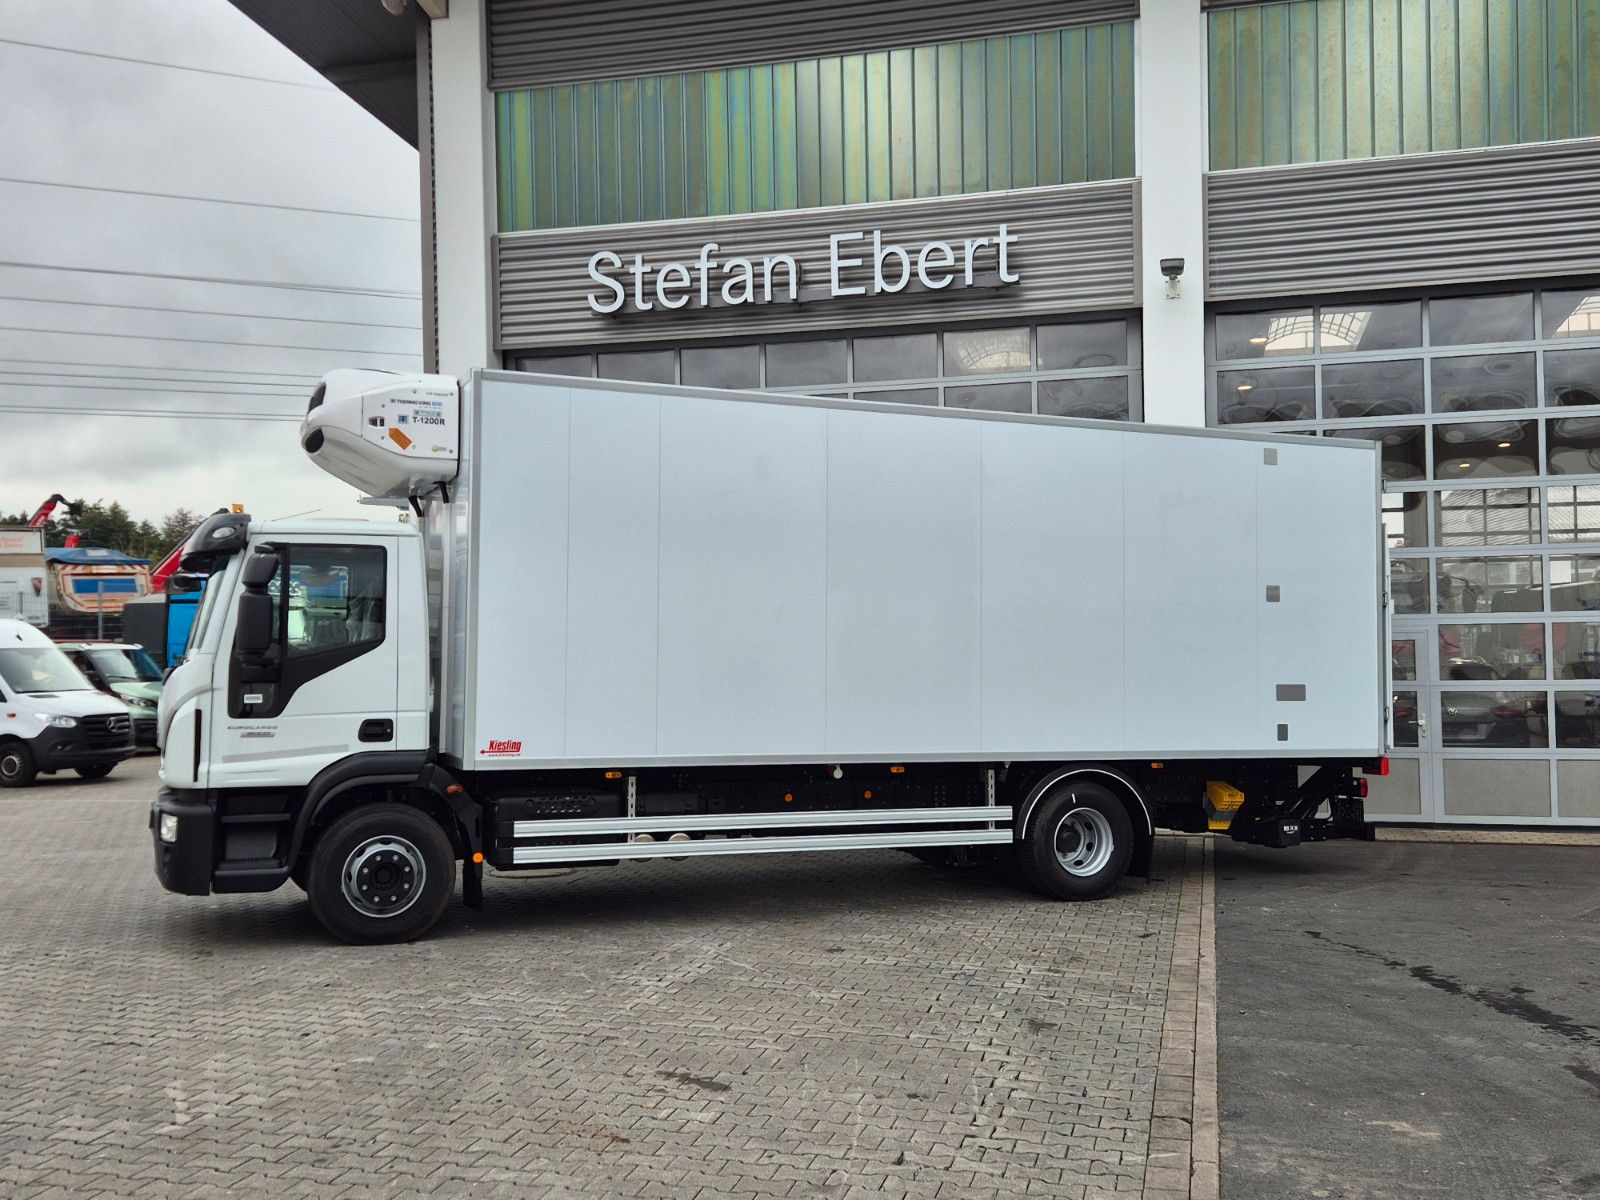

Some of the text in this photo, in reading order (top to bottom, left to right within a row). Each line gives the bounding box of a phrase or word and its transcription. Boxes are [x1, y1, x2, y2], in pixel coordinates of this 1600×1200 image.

[587, 223, 1019, 314] Stefan Ebert
[412, 416, 446, 425] T-1200R
[488, 739, 522, 752] Kiesling
